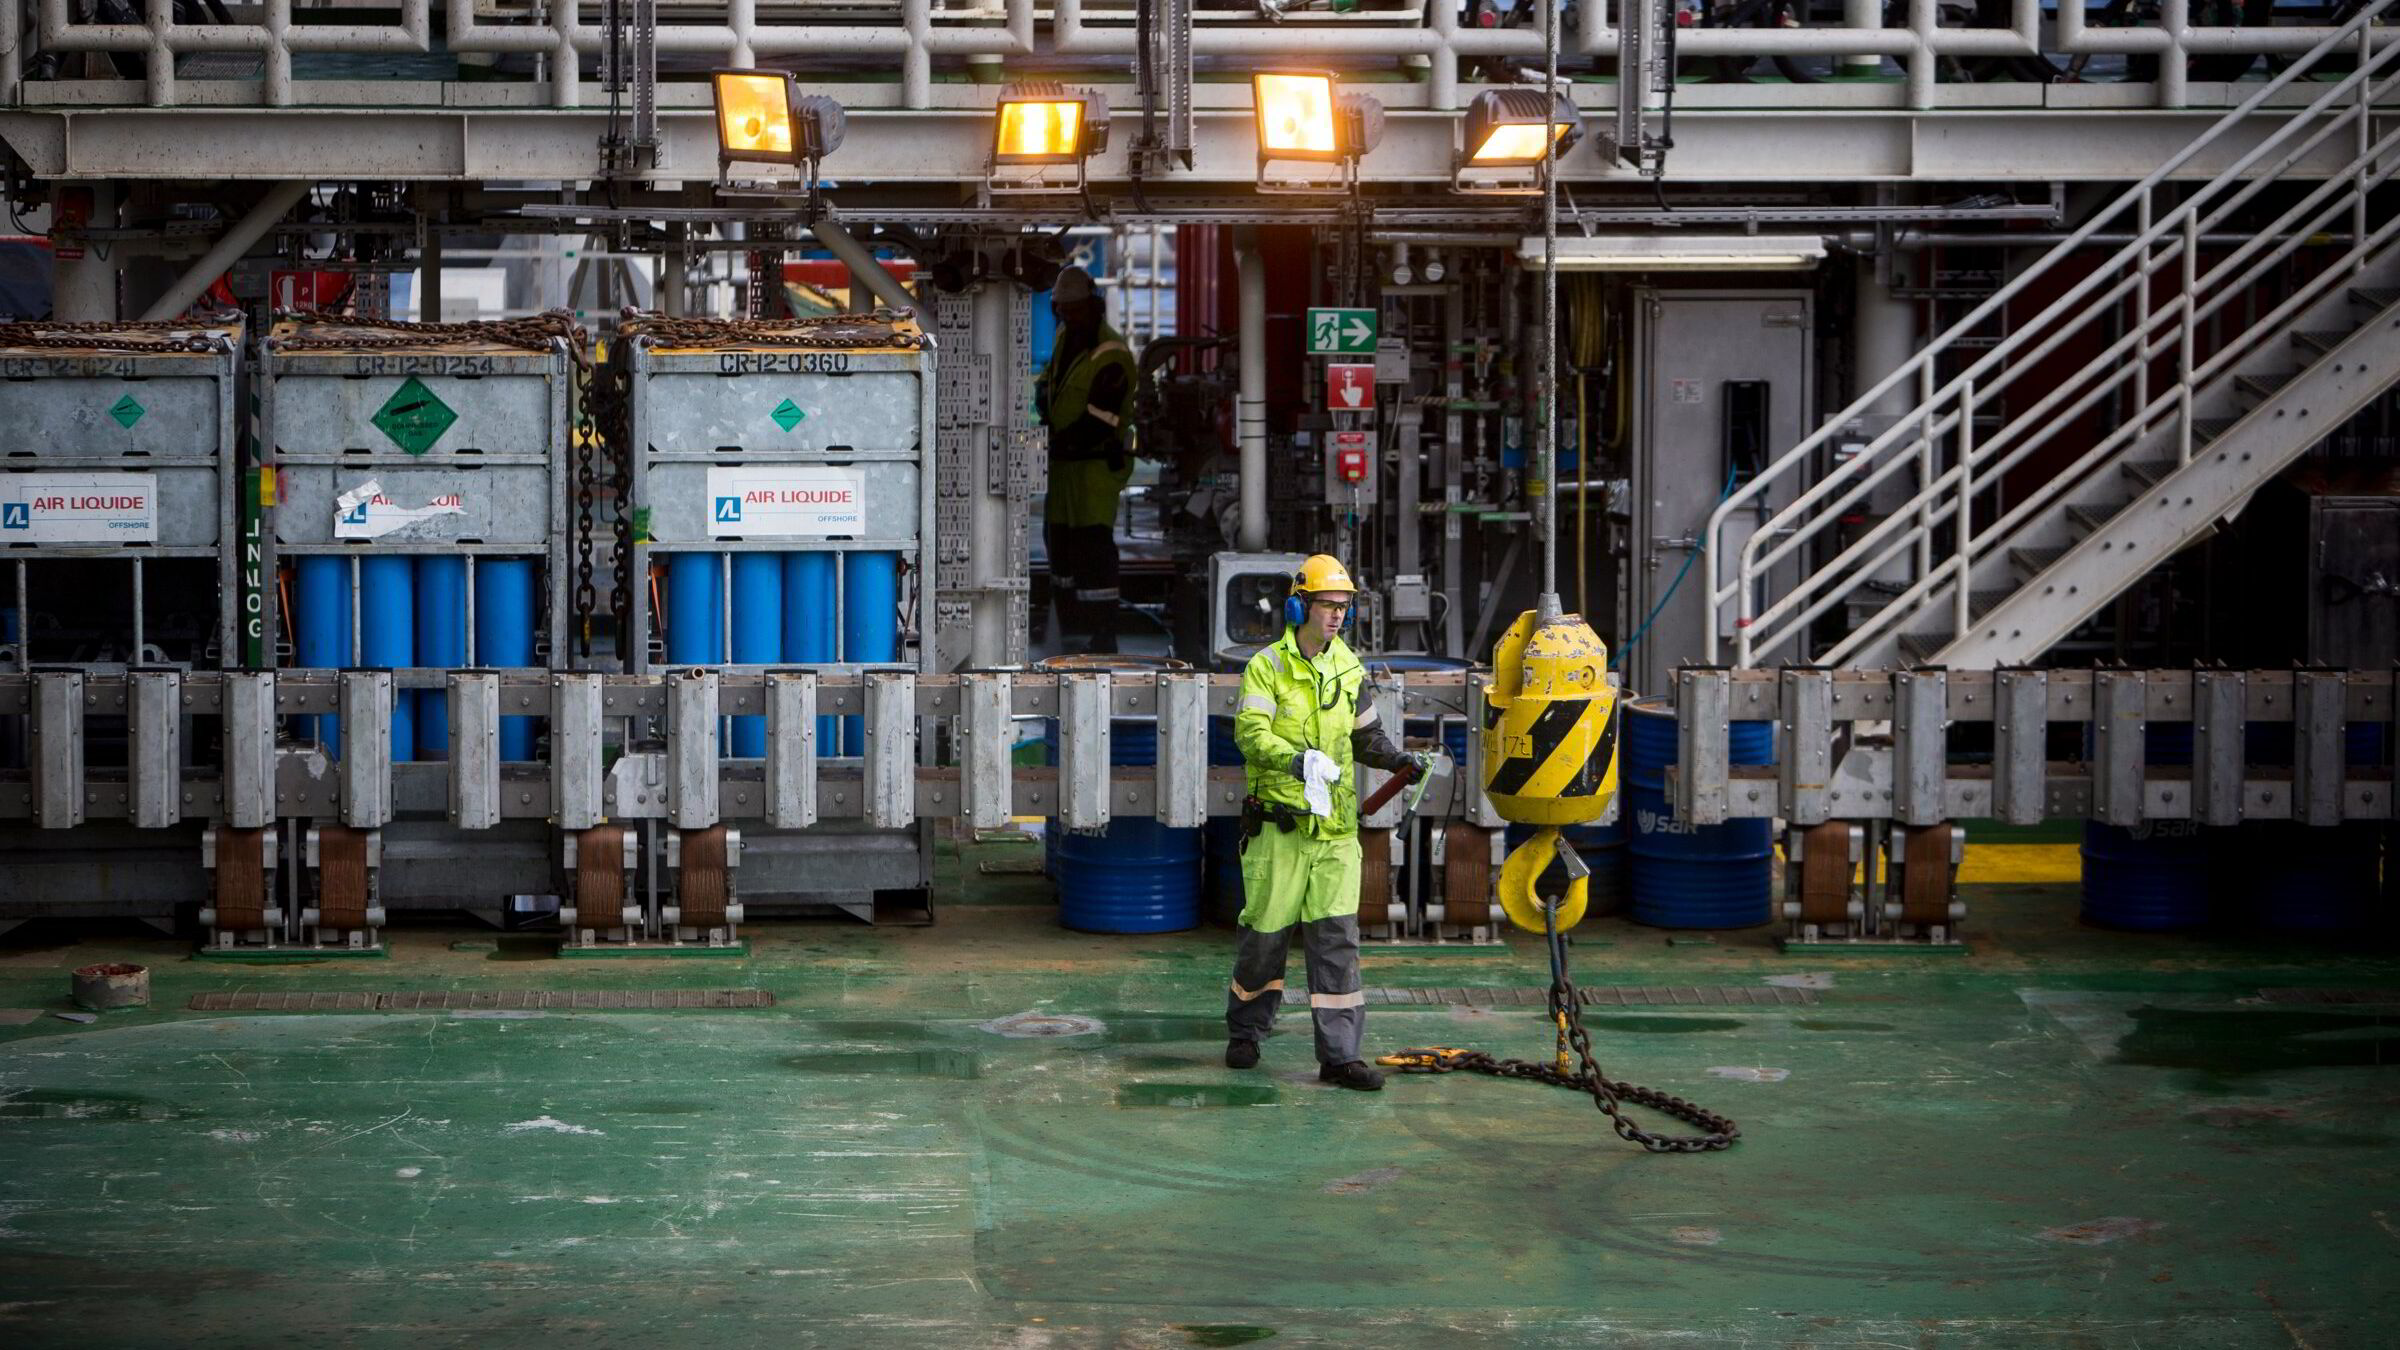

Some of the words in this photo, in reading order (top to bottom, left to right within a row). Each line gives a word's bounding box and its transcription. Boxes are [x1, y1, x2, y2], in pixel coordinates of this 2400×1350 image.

[356, 356, 494, 375] CR-12-0254
[720, 353, 849, 373] CR-12-0360
[33, 496, 65, 510] AIR
[71, 496, 144, 510] LIQUIDE
[745, 490, 775, 503] AIR
[781, 490, 853, 503] LIQUIDE
[108, 521, 149, 529] OFFSHORE
